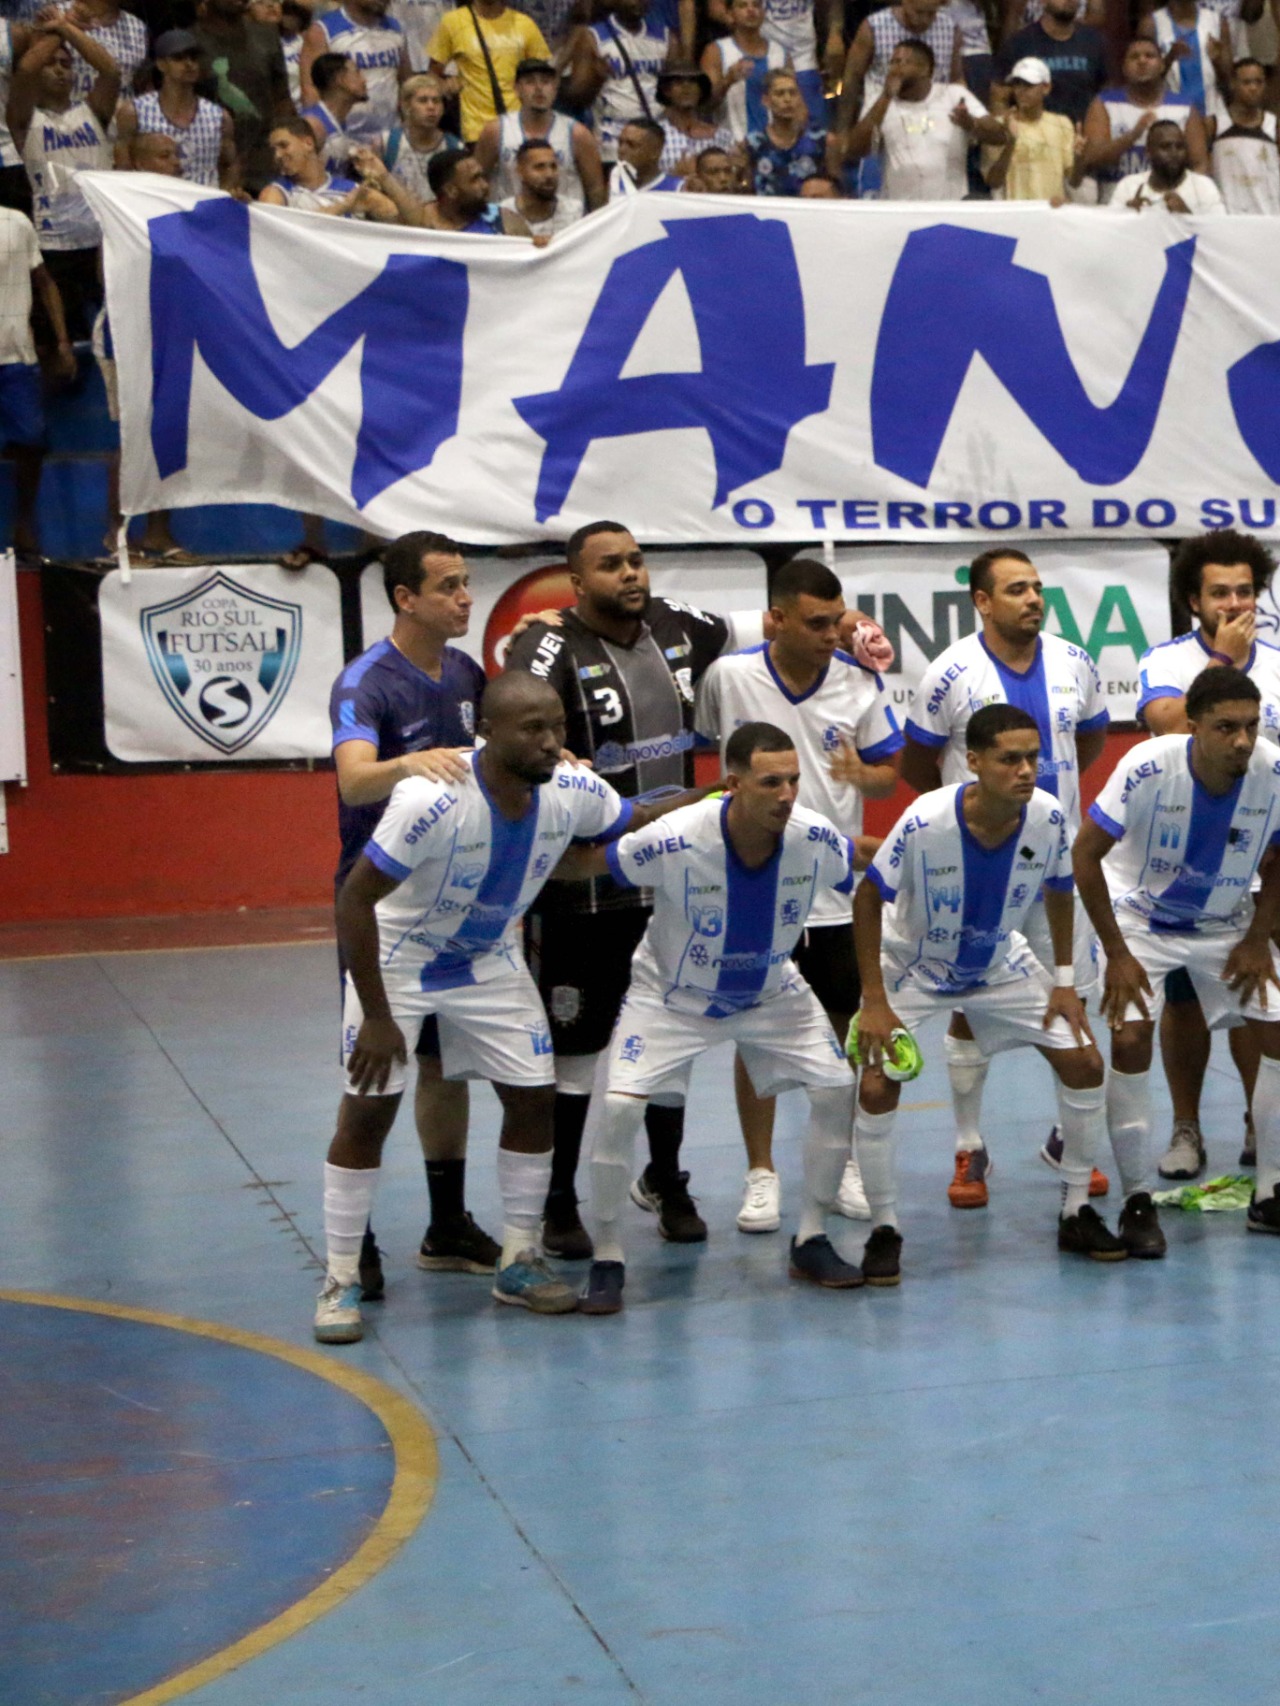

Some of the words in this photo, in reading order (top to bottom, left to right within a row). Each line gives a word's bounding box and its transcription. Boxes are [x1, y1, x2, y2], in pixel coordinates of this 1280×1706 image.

[732, 498, 776, 530] O
[797, 499, 1067, 530] TERROR
[1092, 498, 1178, 528] DO
[202, 597, 239, 610] COPA
[181, 610, 220, 627] RIO
[224, 610, 263, 627] SUL
[170, 630, 276, 654] FUTSAL
[194, 659, 212, 674] 30
[216, 657, 254, 674] anos
[926, 661, 968, 716] SMJEL
[556, 773, 608, 800] SMJE
[403, 790, 459, 847] SMJEL
[632, 834, 694, 868] SMJEL
